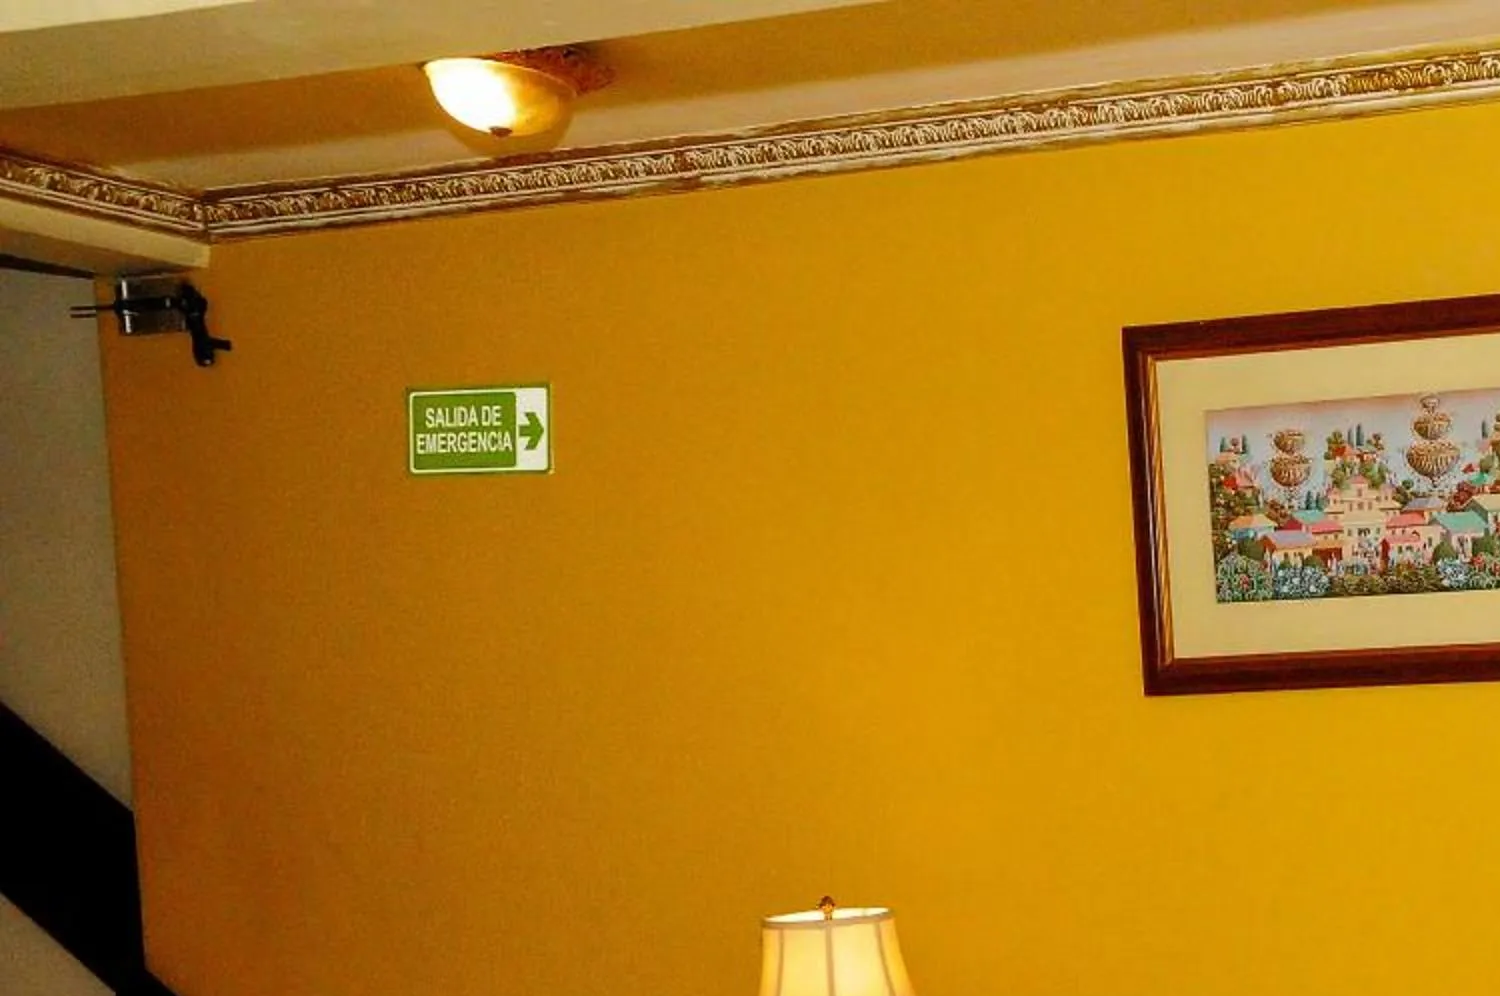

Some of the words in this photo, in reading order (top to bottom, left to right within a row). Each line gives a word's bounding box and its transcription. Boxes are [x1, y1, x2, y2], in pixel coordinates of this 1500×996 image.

[425, 405, 479, 428] SALIDA
[481, 405, 502, 427] DE
[415, 431, 513, 454] EMERGENCIA
